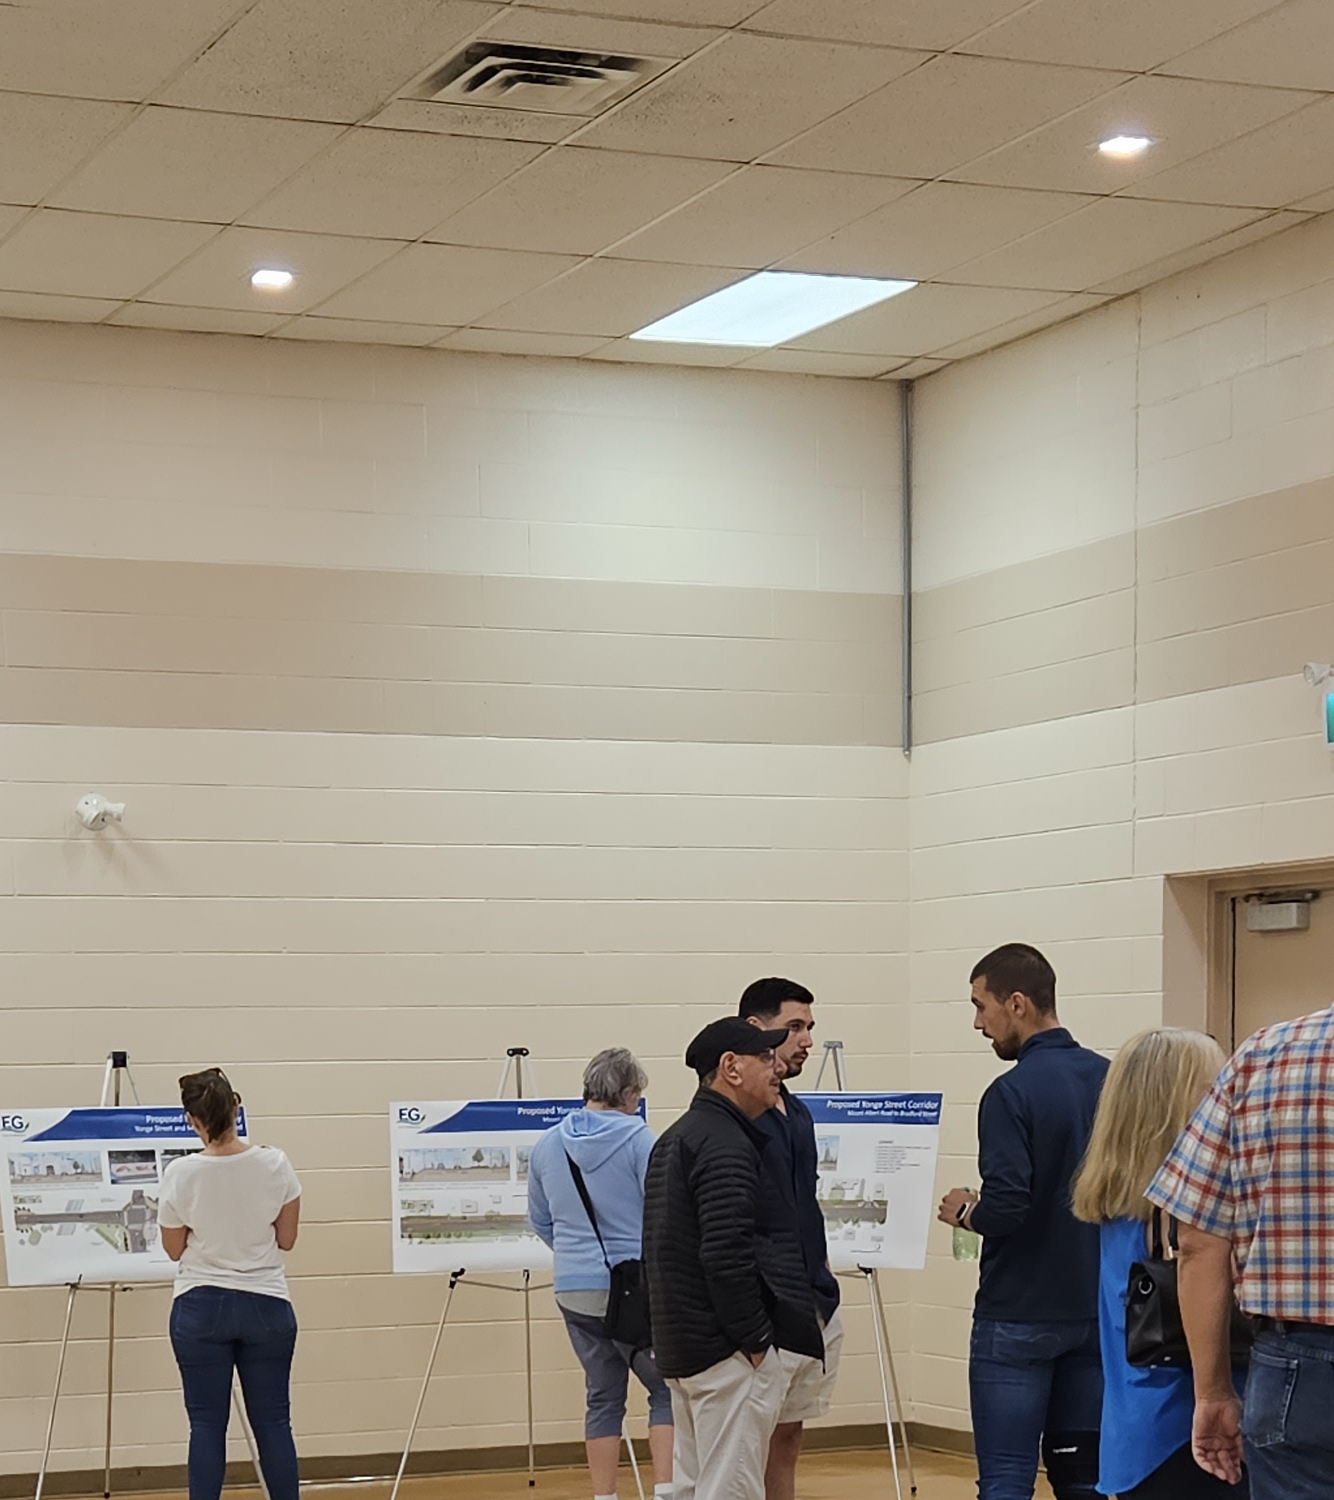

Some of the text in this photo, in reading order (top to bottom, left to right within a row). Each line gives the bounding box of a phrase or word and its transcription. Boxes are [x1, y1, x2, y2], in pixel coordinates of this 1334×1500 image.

[827, 1099, 939, 1110] Proposed Yonge Street Corridor
[398, 1107, 421, 1122] EG
[517, 1106, 556, 1117] Proposed
[1, 1115, 25, 1129] EG
[145, 1114, 183, 1126] Proposed
